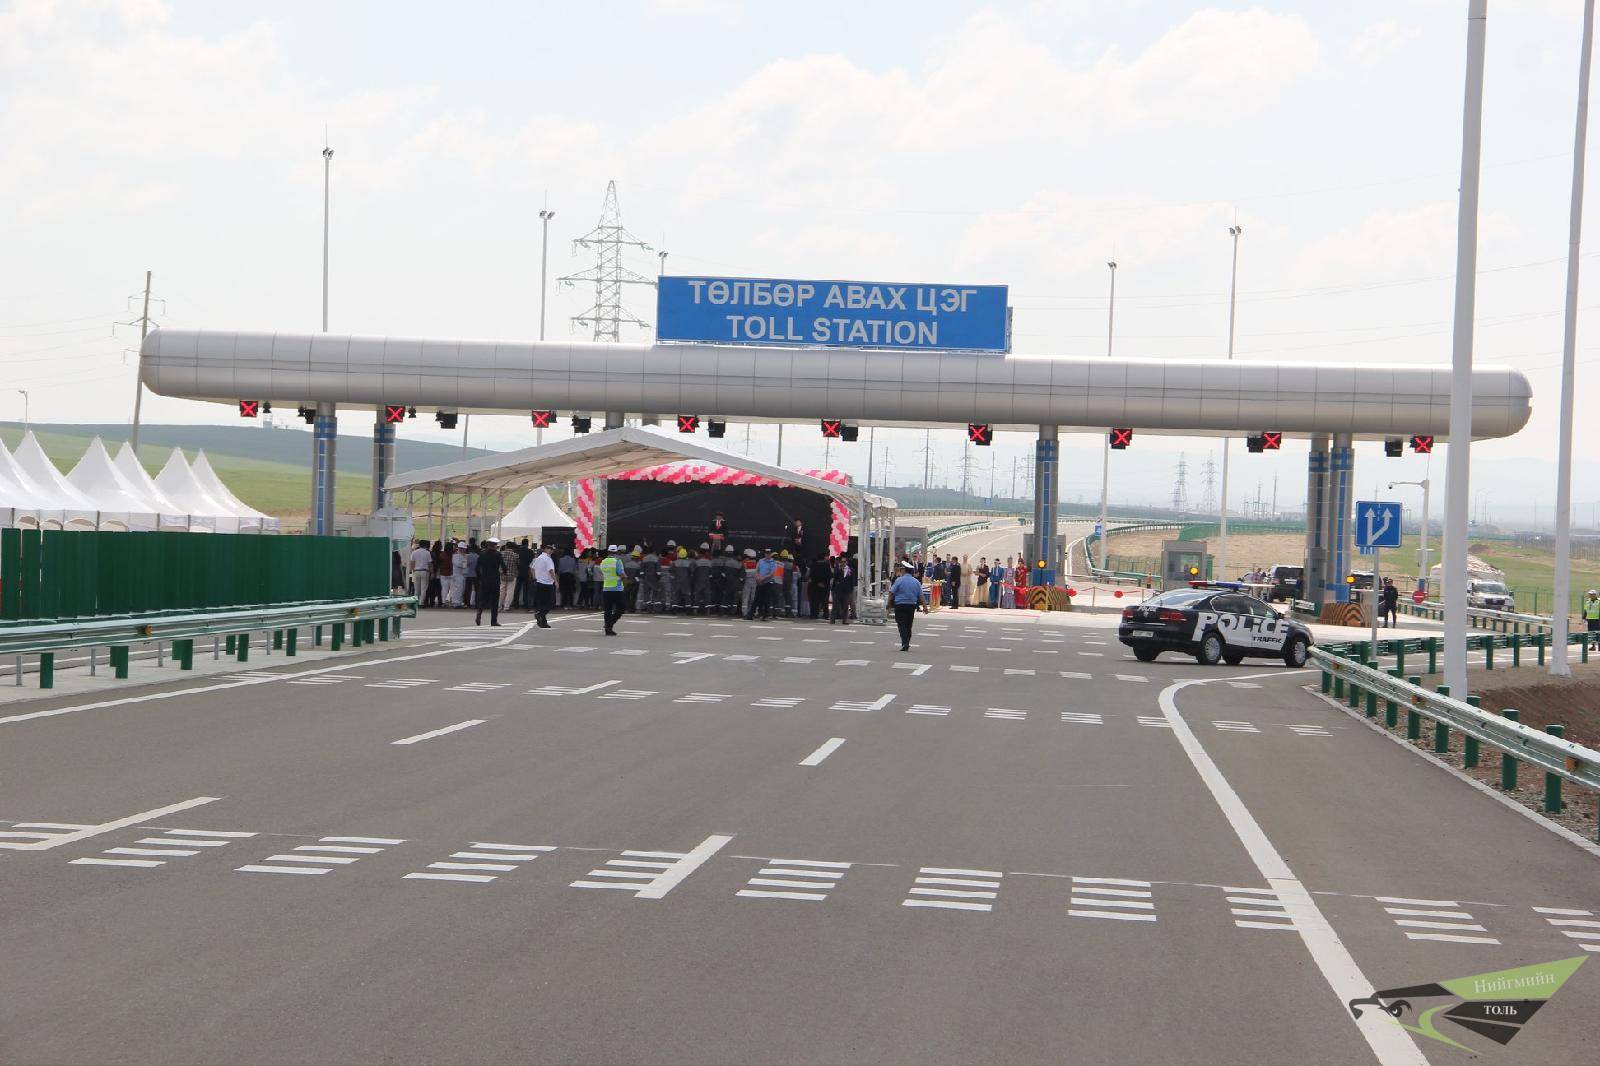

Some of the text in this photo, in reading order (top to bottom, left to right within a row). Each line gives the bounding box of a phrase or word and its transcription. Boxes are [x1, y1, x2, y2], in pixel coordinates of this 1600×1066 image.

[688, 280, 978, 315] ТӨЛБӨР АВАХ ЦЭГ
[726, 315, 938, 345] TOLL STATION
